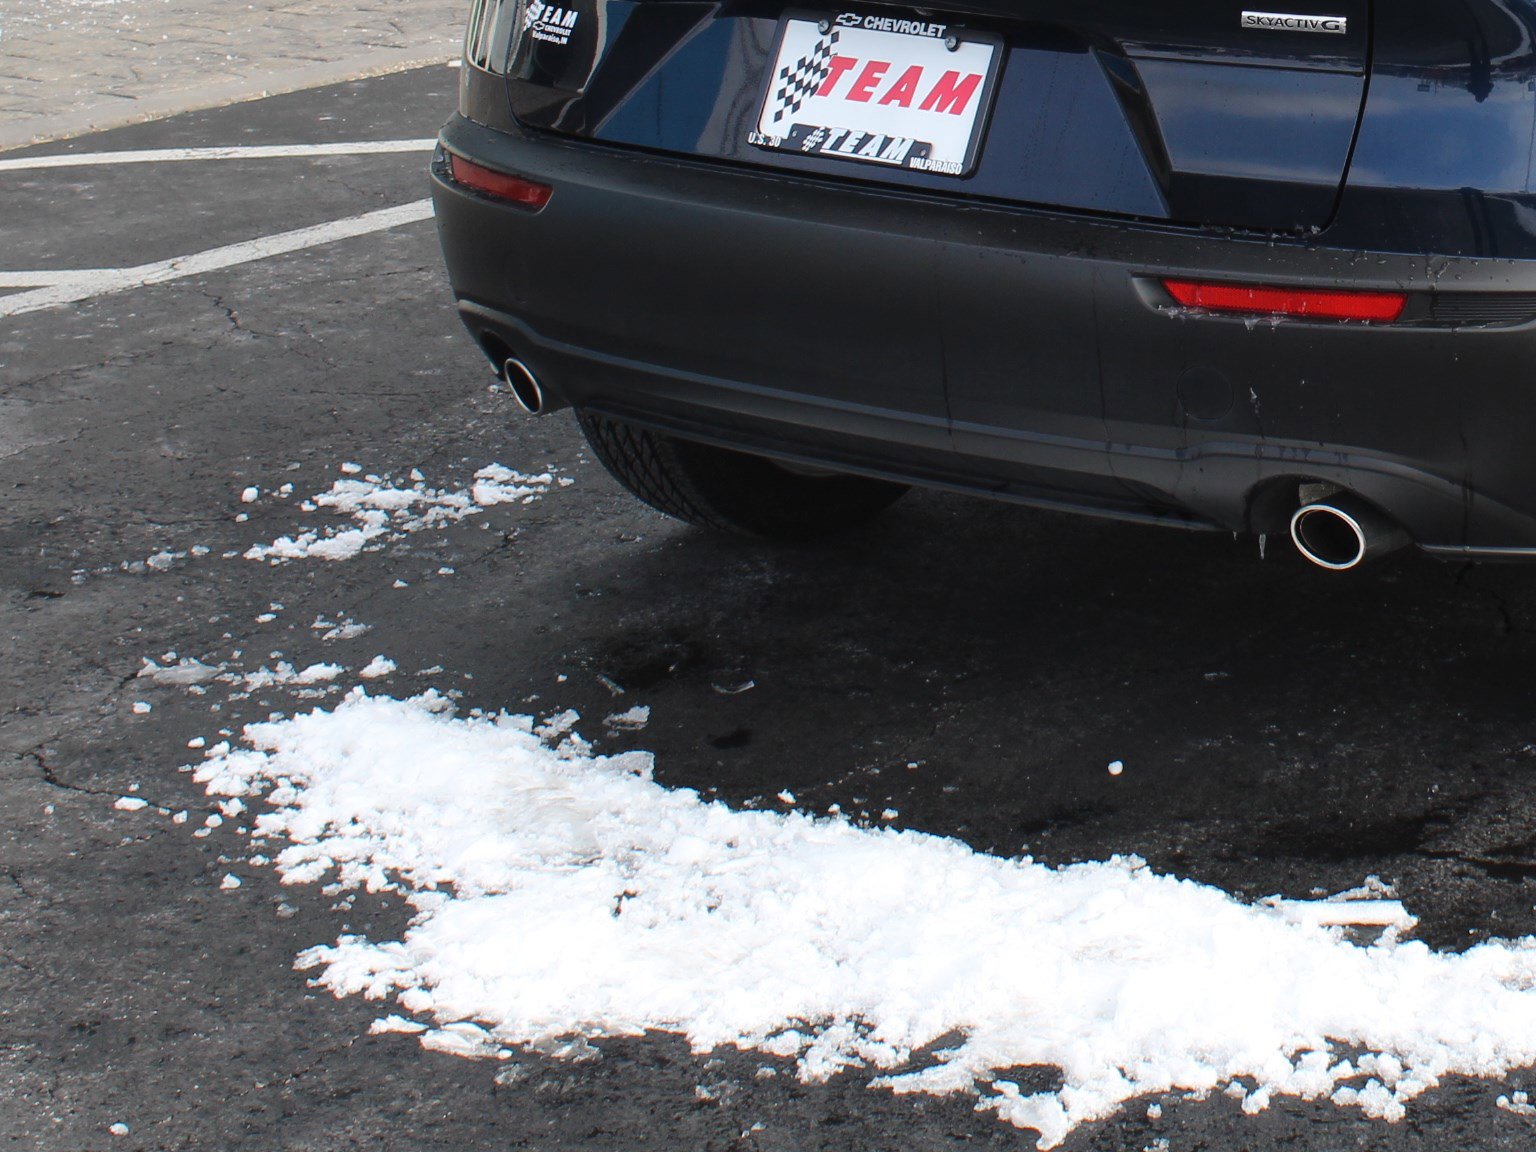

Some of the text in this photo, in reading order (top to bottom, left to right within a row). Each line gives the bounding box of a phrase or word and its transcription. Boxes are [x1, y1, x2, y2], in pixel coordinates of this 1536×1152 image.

[863, 15, 947, 38] CHEVROLET
[815, 54, 984, 116] TEAM
[747, 131, 782, 148] U.S. 30
[820, 127, 915, 164] TEAM
[908, 156, 963, 176] VALPARAISO
